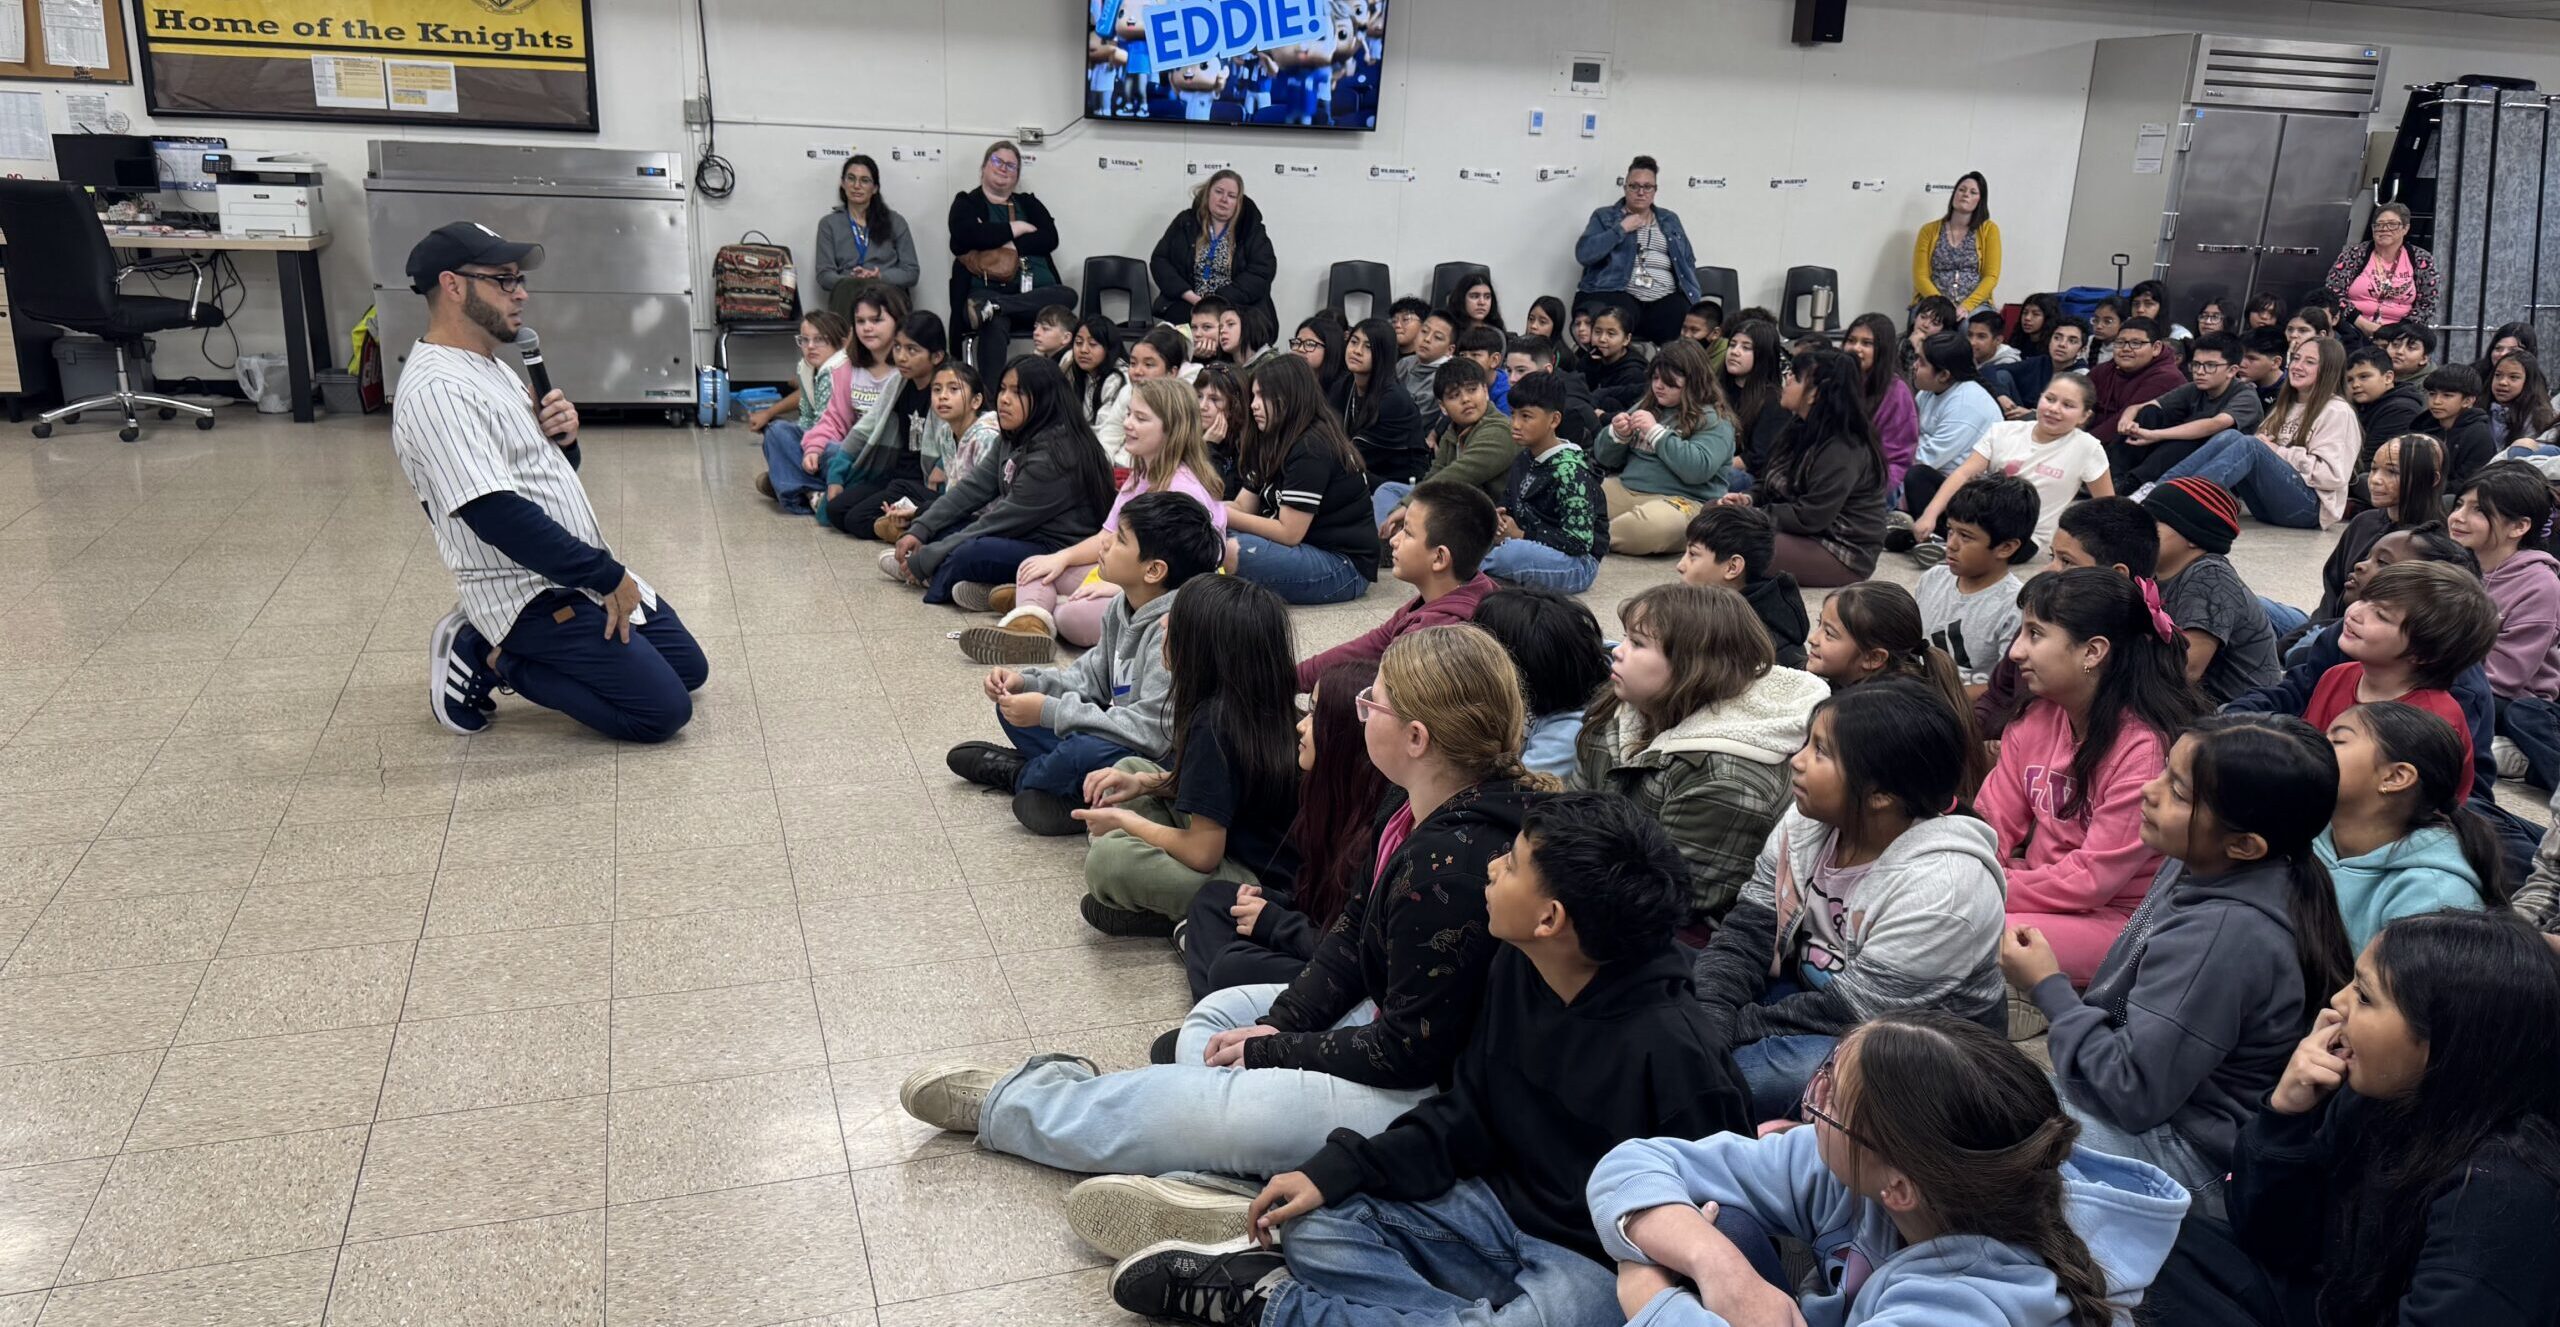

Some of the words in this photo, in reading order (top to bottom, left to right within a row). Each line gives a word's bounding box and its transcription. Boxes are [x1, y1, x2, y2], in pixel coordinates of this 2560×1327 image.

[153, 8, 280, 36] Home
[293, 18, 333, 38] of
[343, 19, 406, 41] the
[417, 22, 574, 52] Knights
[1151, 0, 1320, 63] EDDIE!
[822, 149, 850, 157] TORRES
